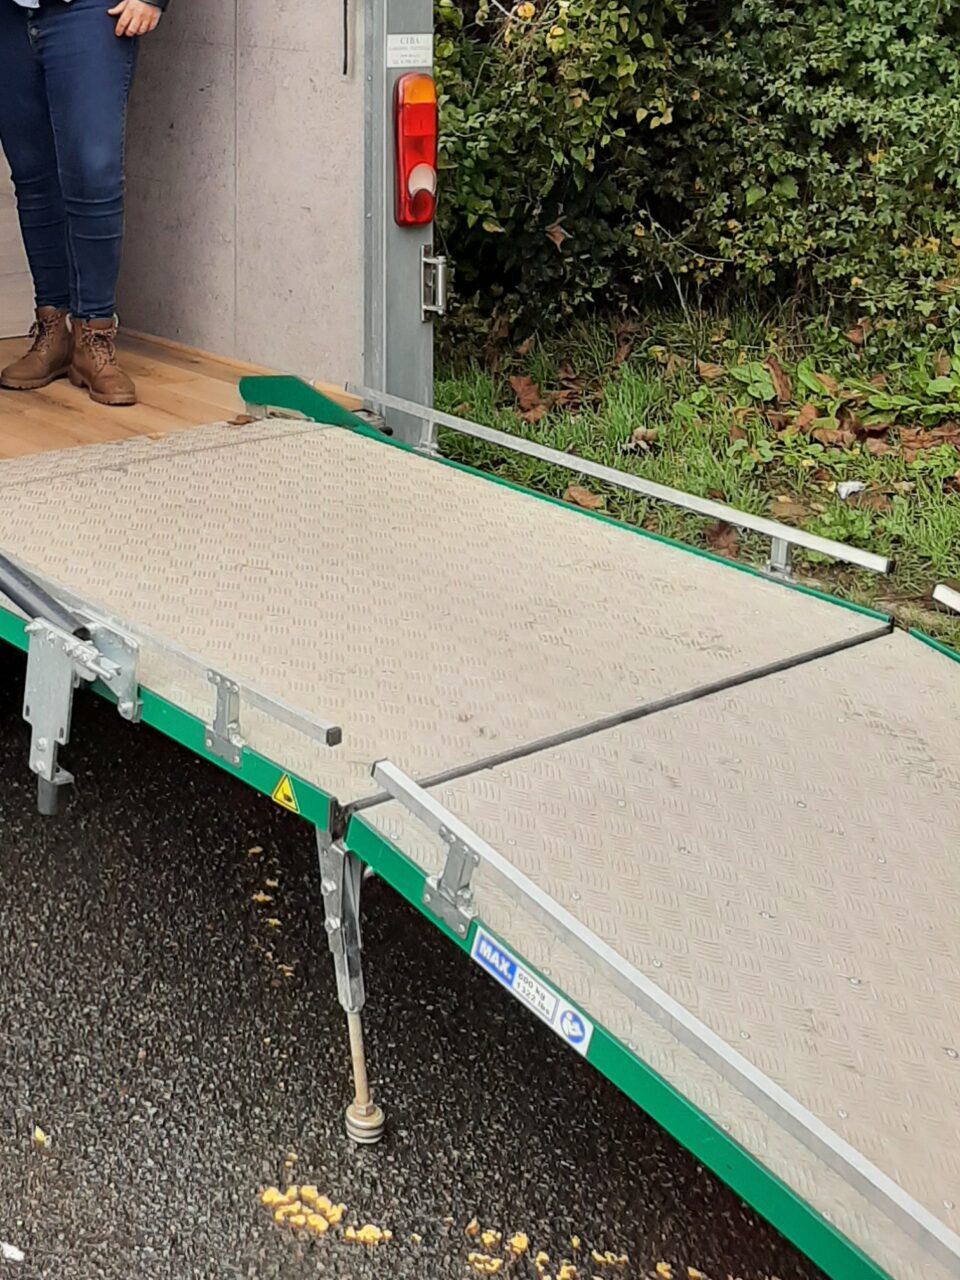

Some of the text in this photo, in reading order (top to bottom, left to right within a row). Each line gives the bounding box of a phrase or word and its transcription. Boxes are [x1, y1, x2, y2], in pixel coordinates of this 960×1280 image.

[479, 942, 513, 980] MAX.
[517, 982, 536, 1001] 1322
[518, 973, 546, 1001] 600 kg
